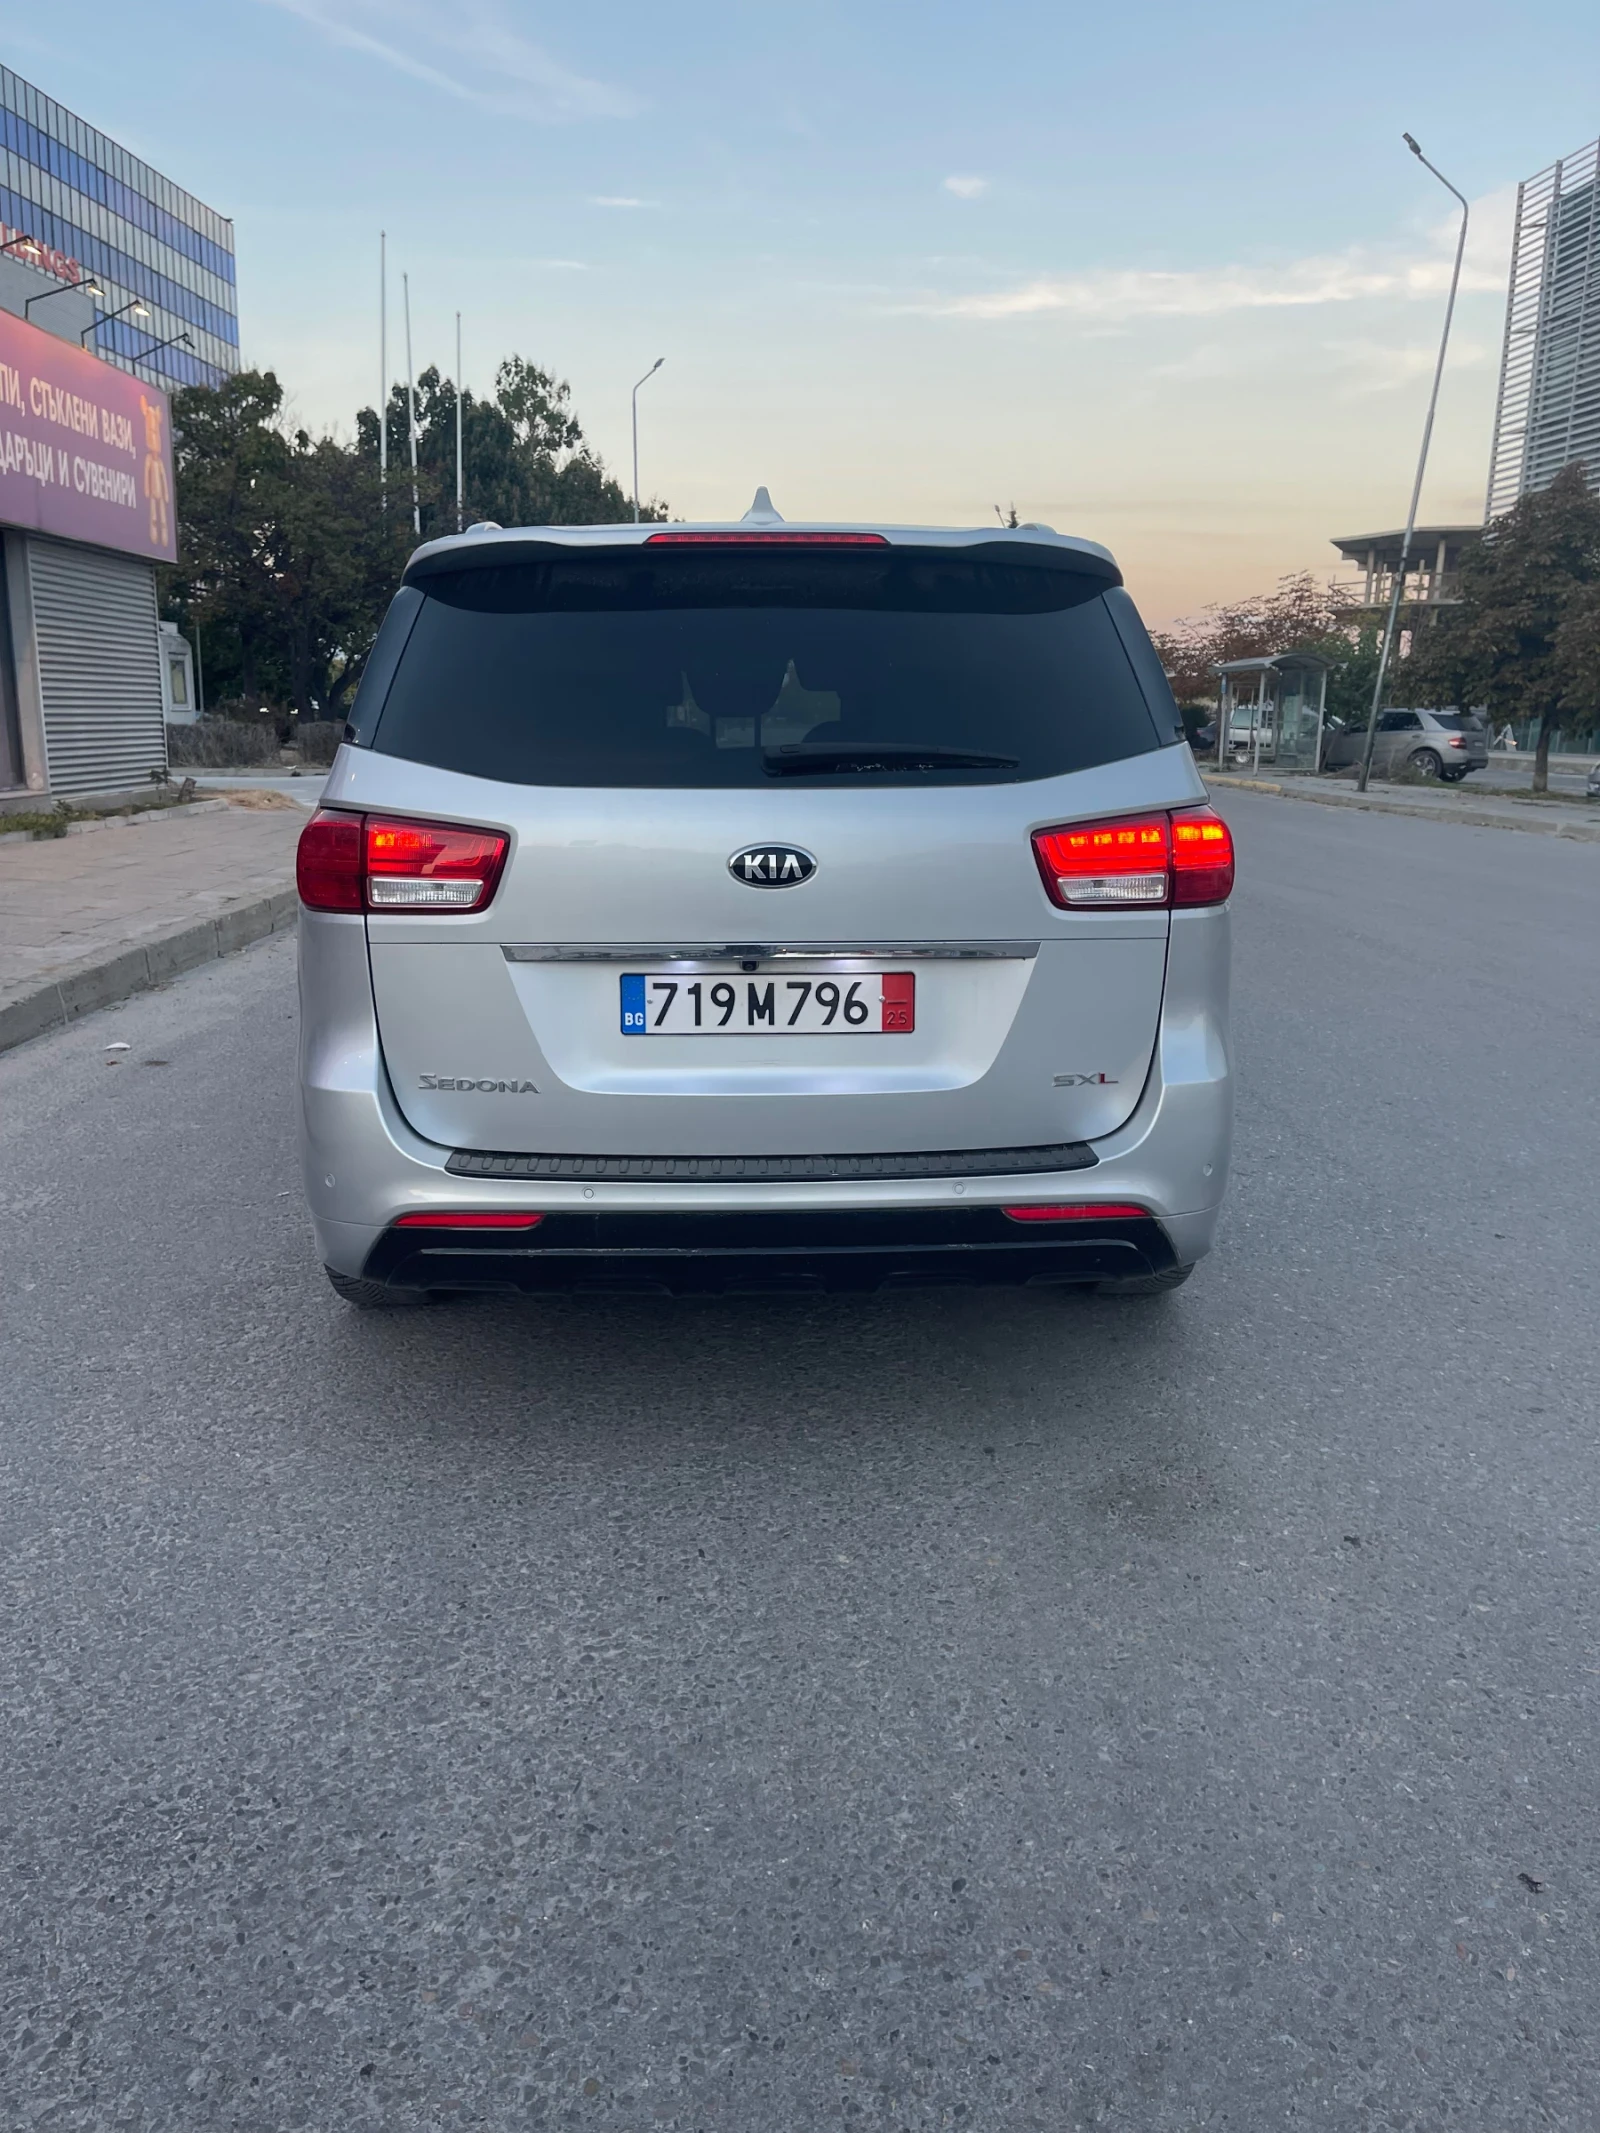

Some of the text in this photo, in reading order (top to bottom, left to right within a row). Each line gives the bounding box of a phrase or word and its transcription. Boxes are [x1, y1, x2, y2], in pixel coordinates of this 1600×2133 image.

[30, 376, 99, 440] СТЪКЛЕНИ
[101, 407, 137, 460] ВАЗИ,
[58, 448, 70, 488] И
[73, 455, 137, 509] СУВЕНИРИ
[743, 854, 803, 879] KIA
[652, 981, 869, 1027] 719M796
[624, 1012, 644, 1026] BG
[886, 1010, 907, 1025] 25
[1052, 1072, 1119, 1087] SXL
